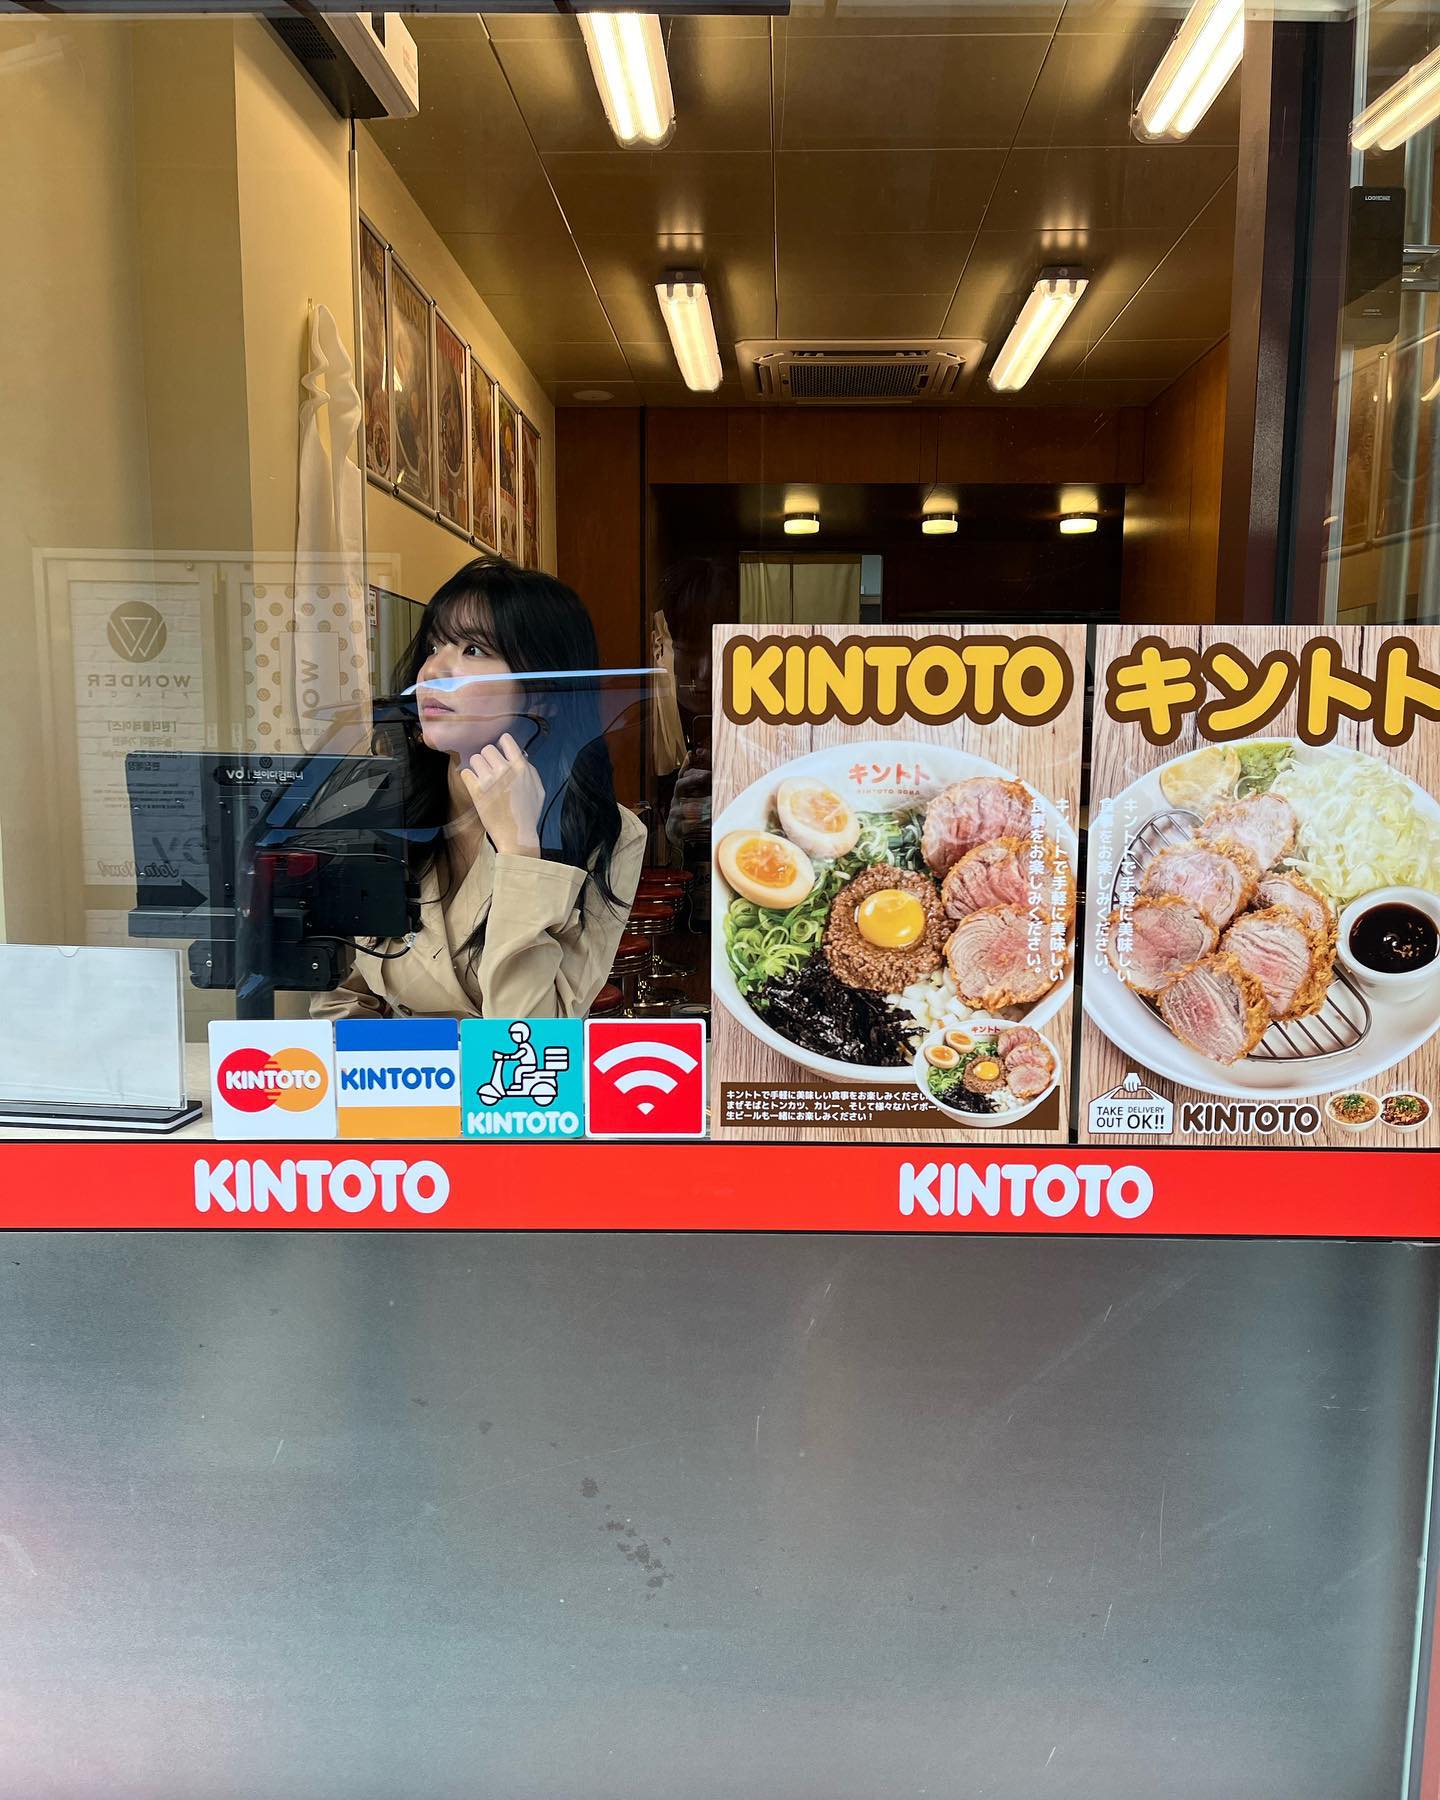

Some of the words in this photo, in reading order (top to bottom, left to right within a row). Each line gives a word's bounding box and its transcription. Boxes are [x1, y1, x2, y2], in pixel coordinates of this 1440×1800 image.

[731, 644, 1065, 717] KINTOTO
[1115, 646, 1440, 736] キントト
[848, 763, 930, 785] キントト
[225, 1069, 322, 1091] KINTOTO
[340, 1067, 456, 1091] KINTOTO
[726, 1101, 940, 1112] まぜそばとトンカツ、カレー、そして様々なハイボー
[1096, 1106, 1124, 1116] TAKE
[1128, 1106, 1165, 1114] DELIVERY
[467, 1111, 579, 1135] KINTOTO
[1096, 1117, 1123, 1128] OUT
[1127, 1115, 1164, 1130] OK!!
[1182, 1105, 1319, 1133] KINTOTO
[194, 1159, 450, 1214] KINTOTO
[899, 1162, 1154, 1219] KINTOTO
